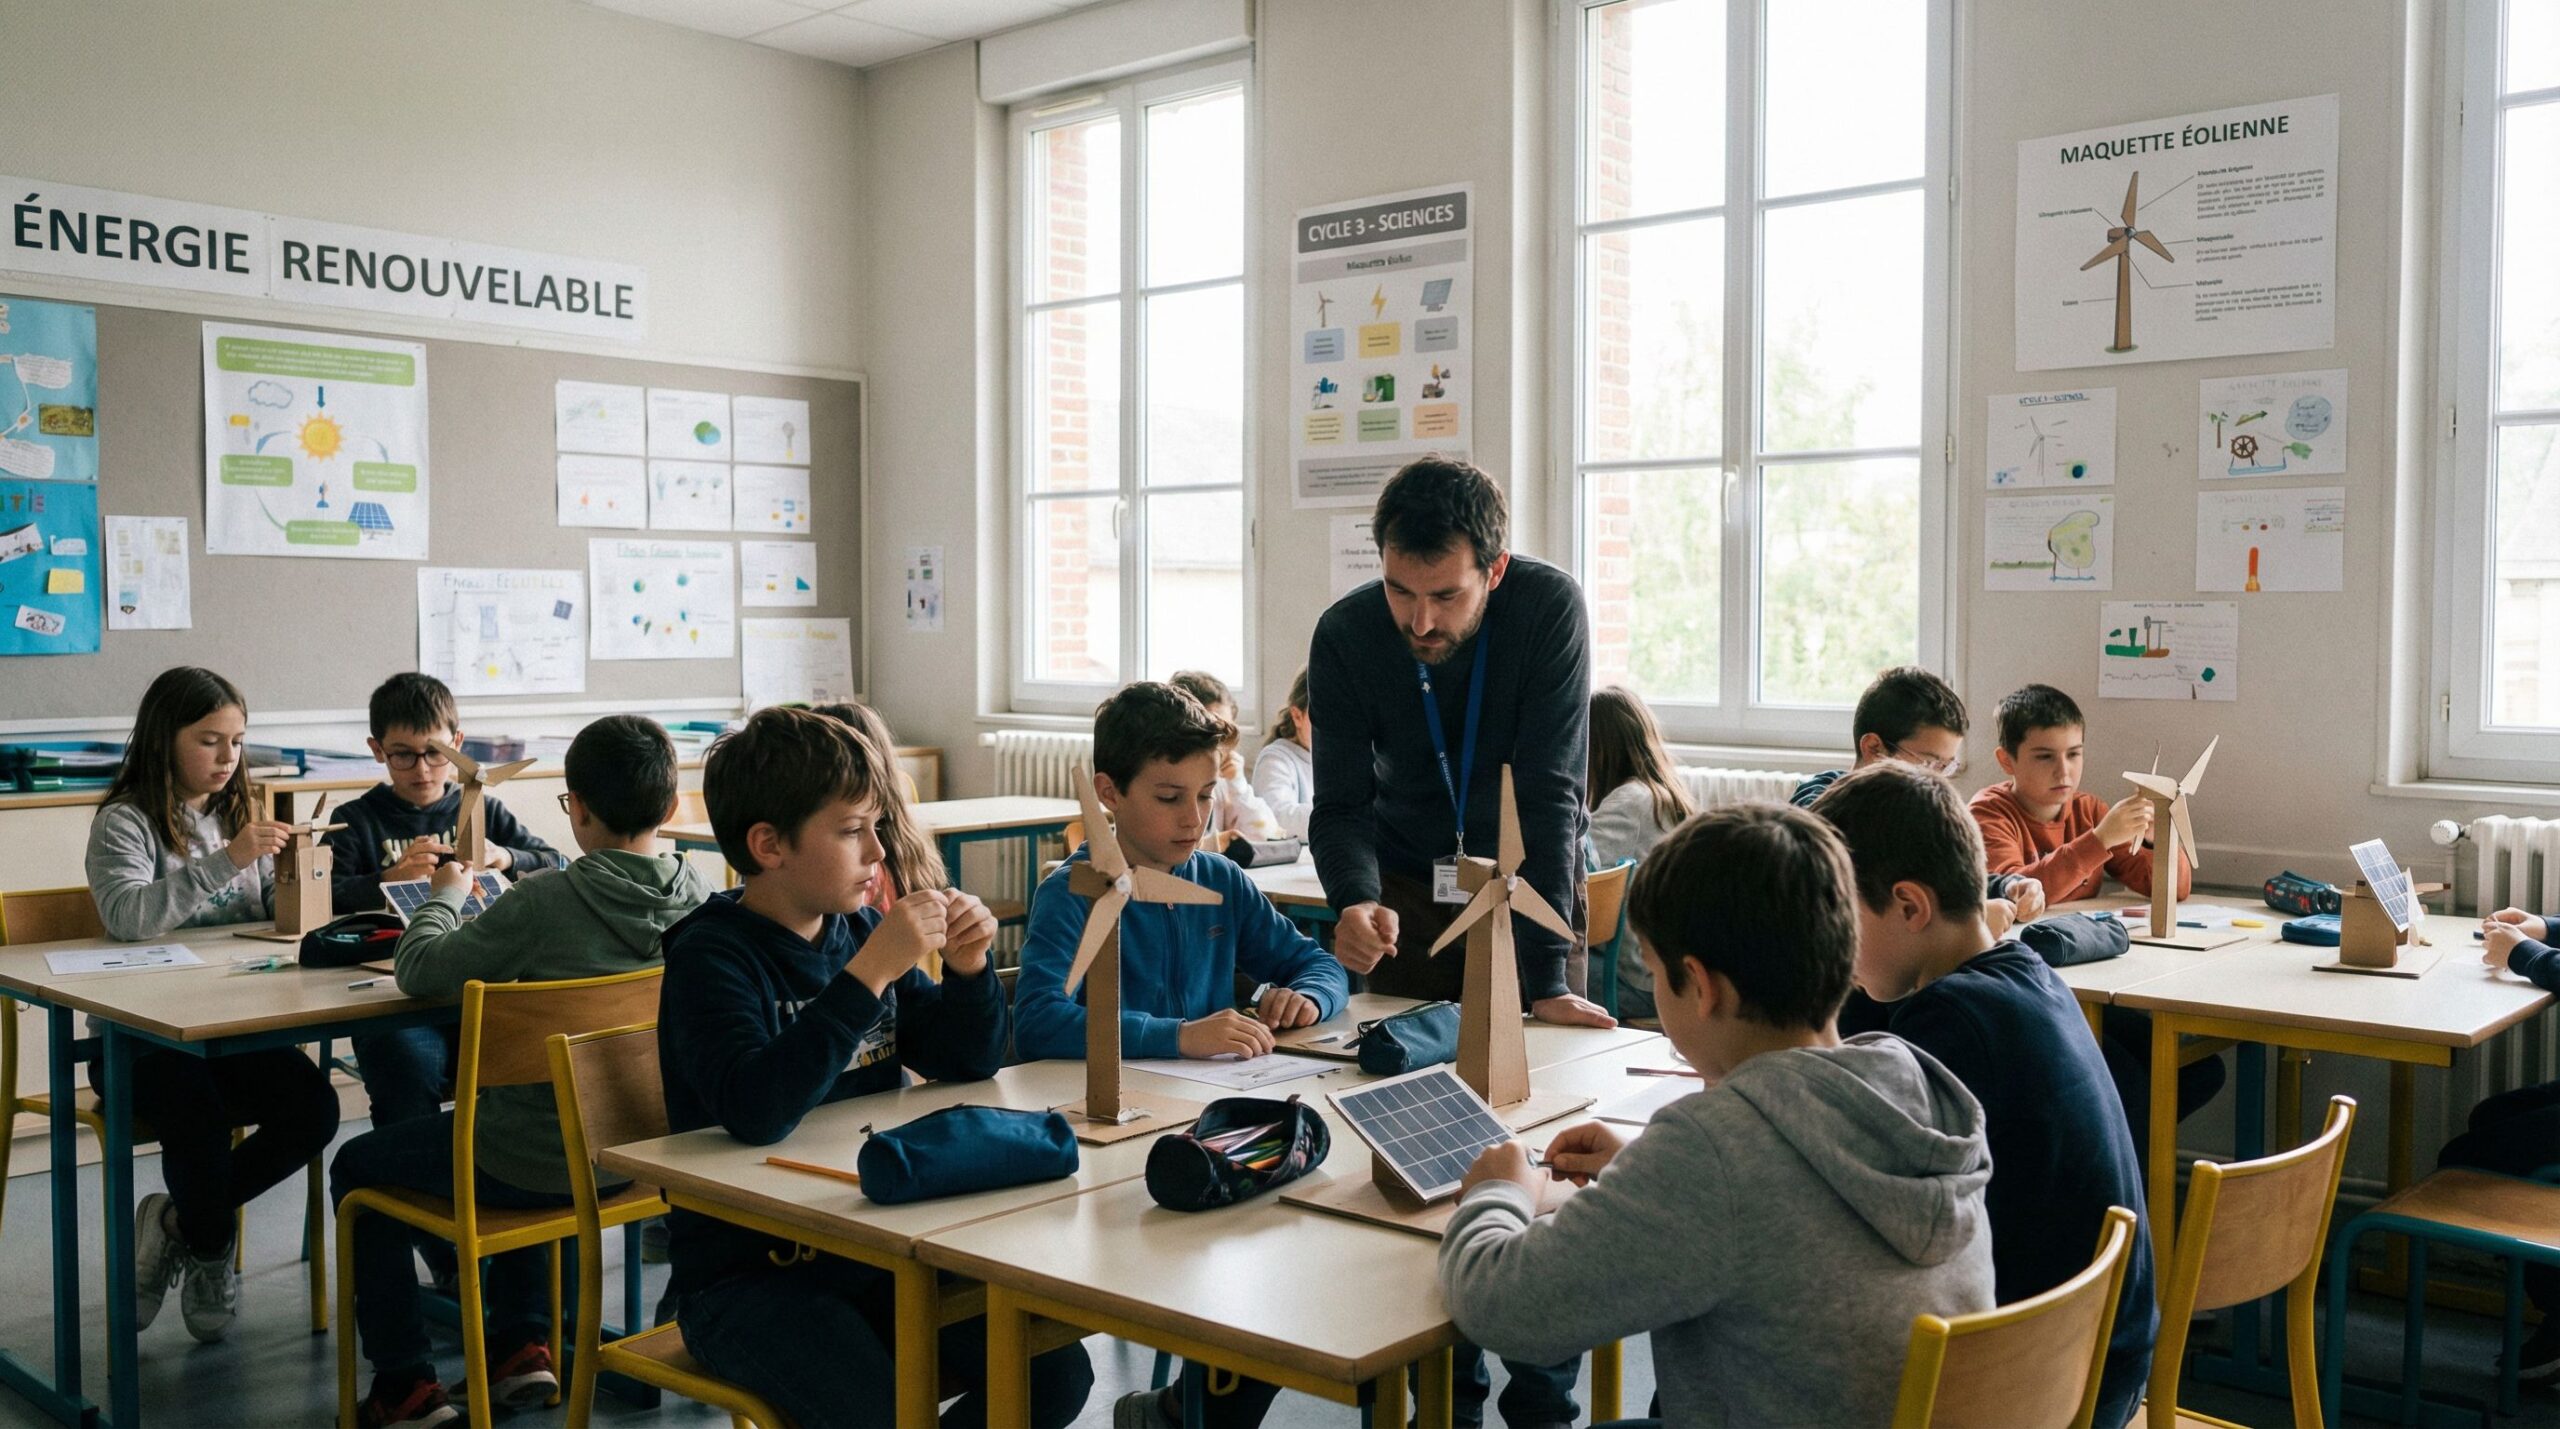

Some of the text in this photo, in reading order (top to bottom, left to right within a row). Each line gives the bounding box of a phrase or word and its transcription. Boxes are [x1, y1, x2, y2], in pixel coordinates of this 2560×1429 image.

[2061, 115, 2290, 164] MAQUETTE ÉOLIENNE
[1308, 219, 1352, 243] CYCLE
[1355, 218, 1366, 236] 3
[1378, 203, 1455, 232] SCIENCES
[13, 193, 634, 319] ÉNERGIE RENOUVELABLE
